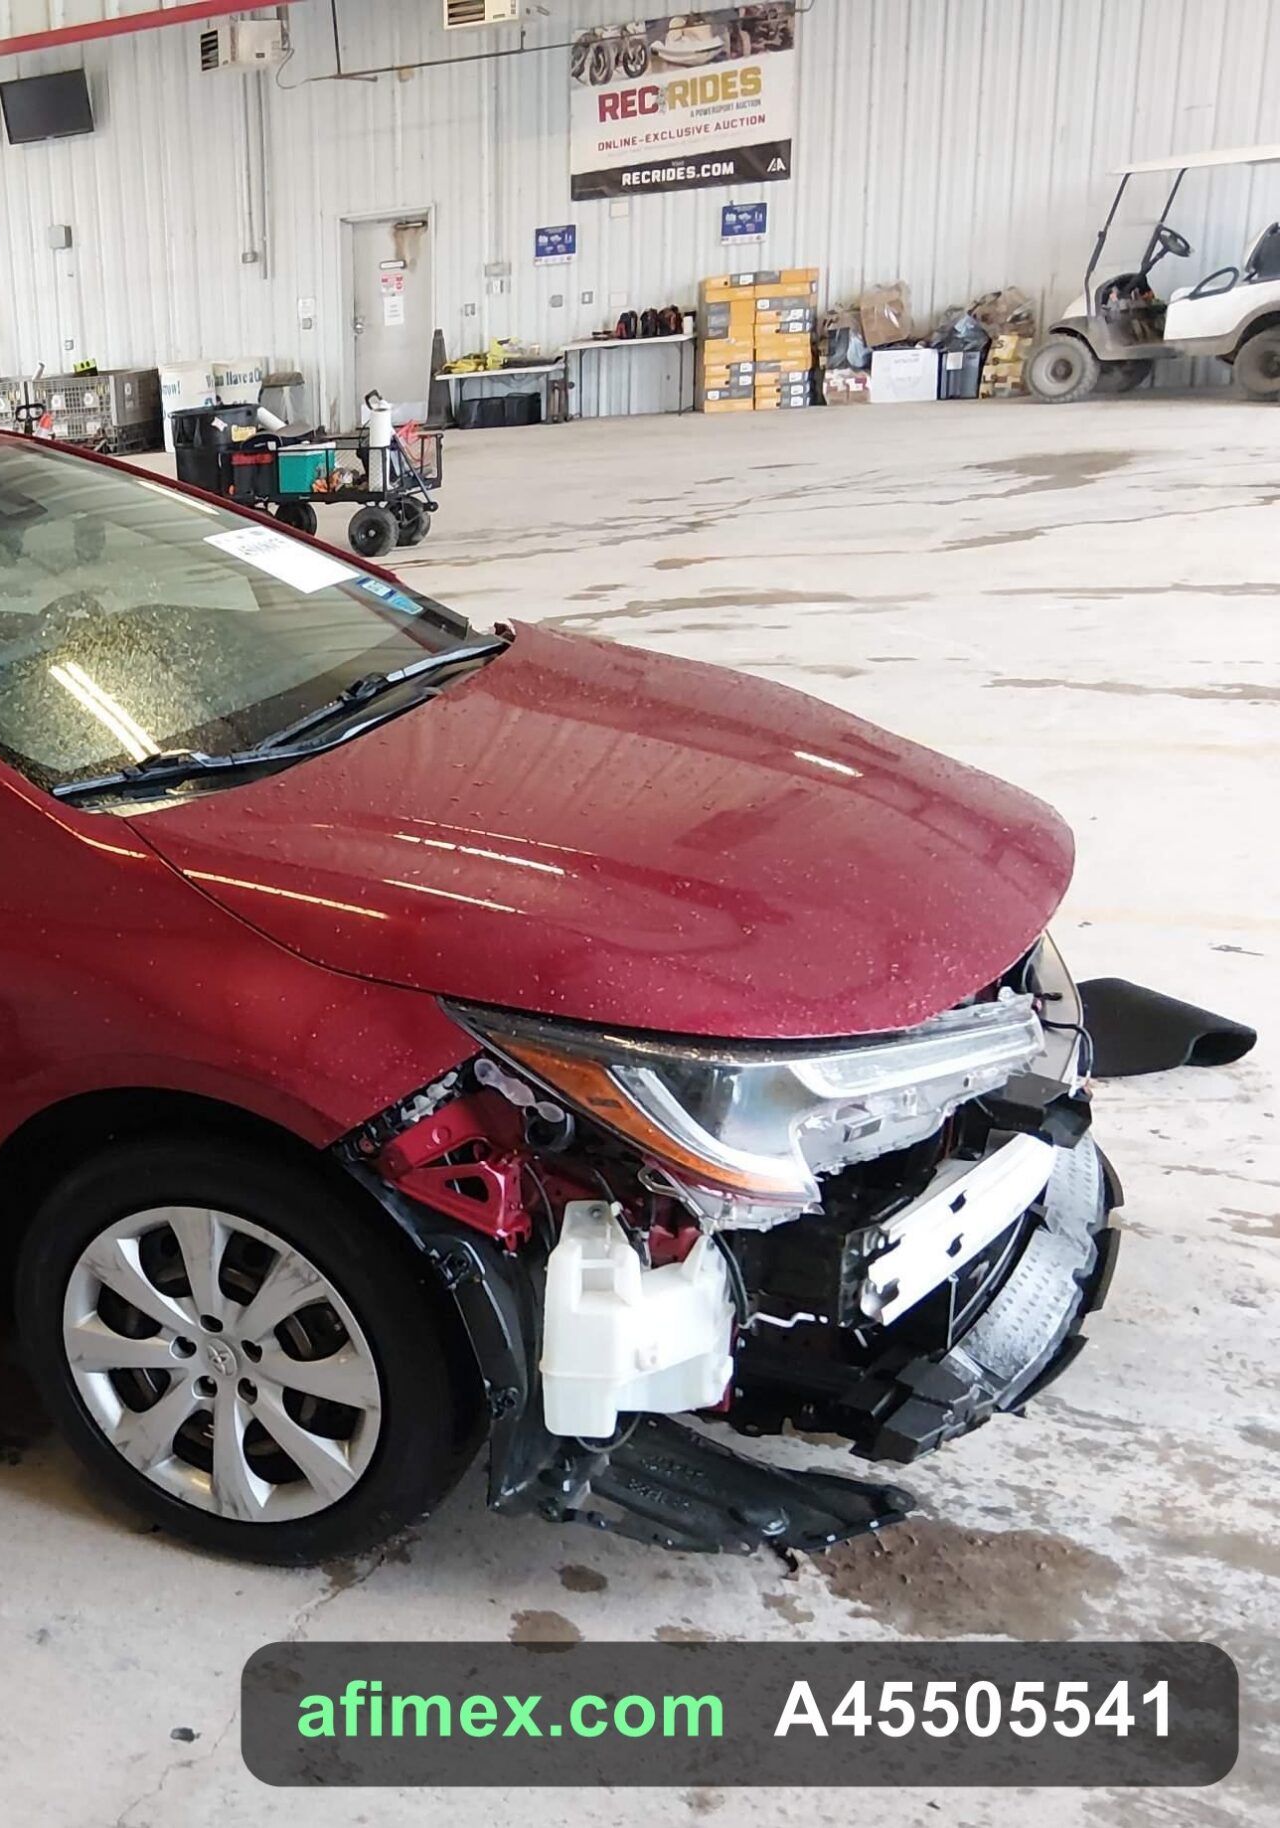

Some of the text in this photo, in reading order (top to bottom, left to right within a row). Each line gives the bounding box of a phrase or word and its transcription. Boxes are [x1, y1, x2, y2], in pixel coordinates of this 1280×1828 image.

[598, 85, 660, 123] REC
[666, 66, 763, 110] RIDES
[597, 122, 711, 151] ONLINE-EXCLUSIVE
[714, 114, 766, 131] AUCTION
[622, 161, 735, 187] RECRIDES.COM
